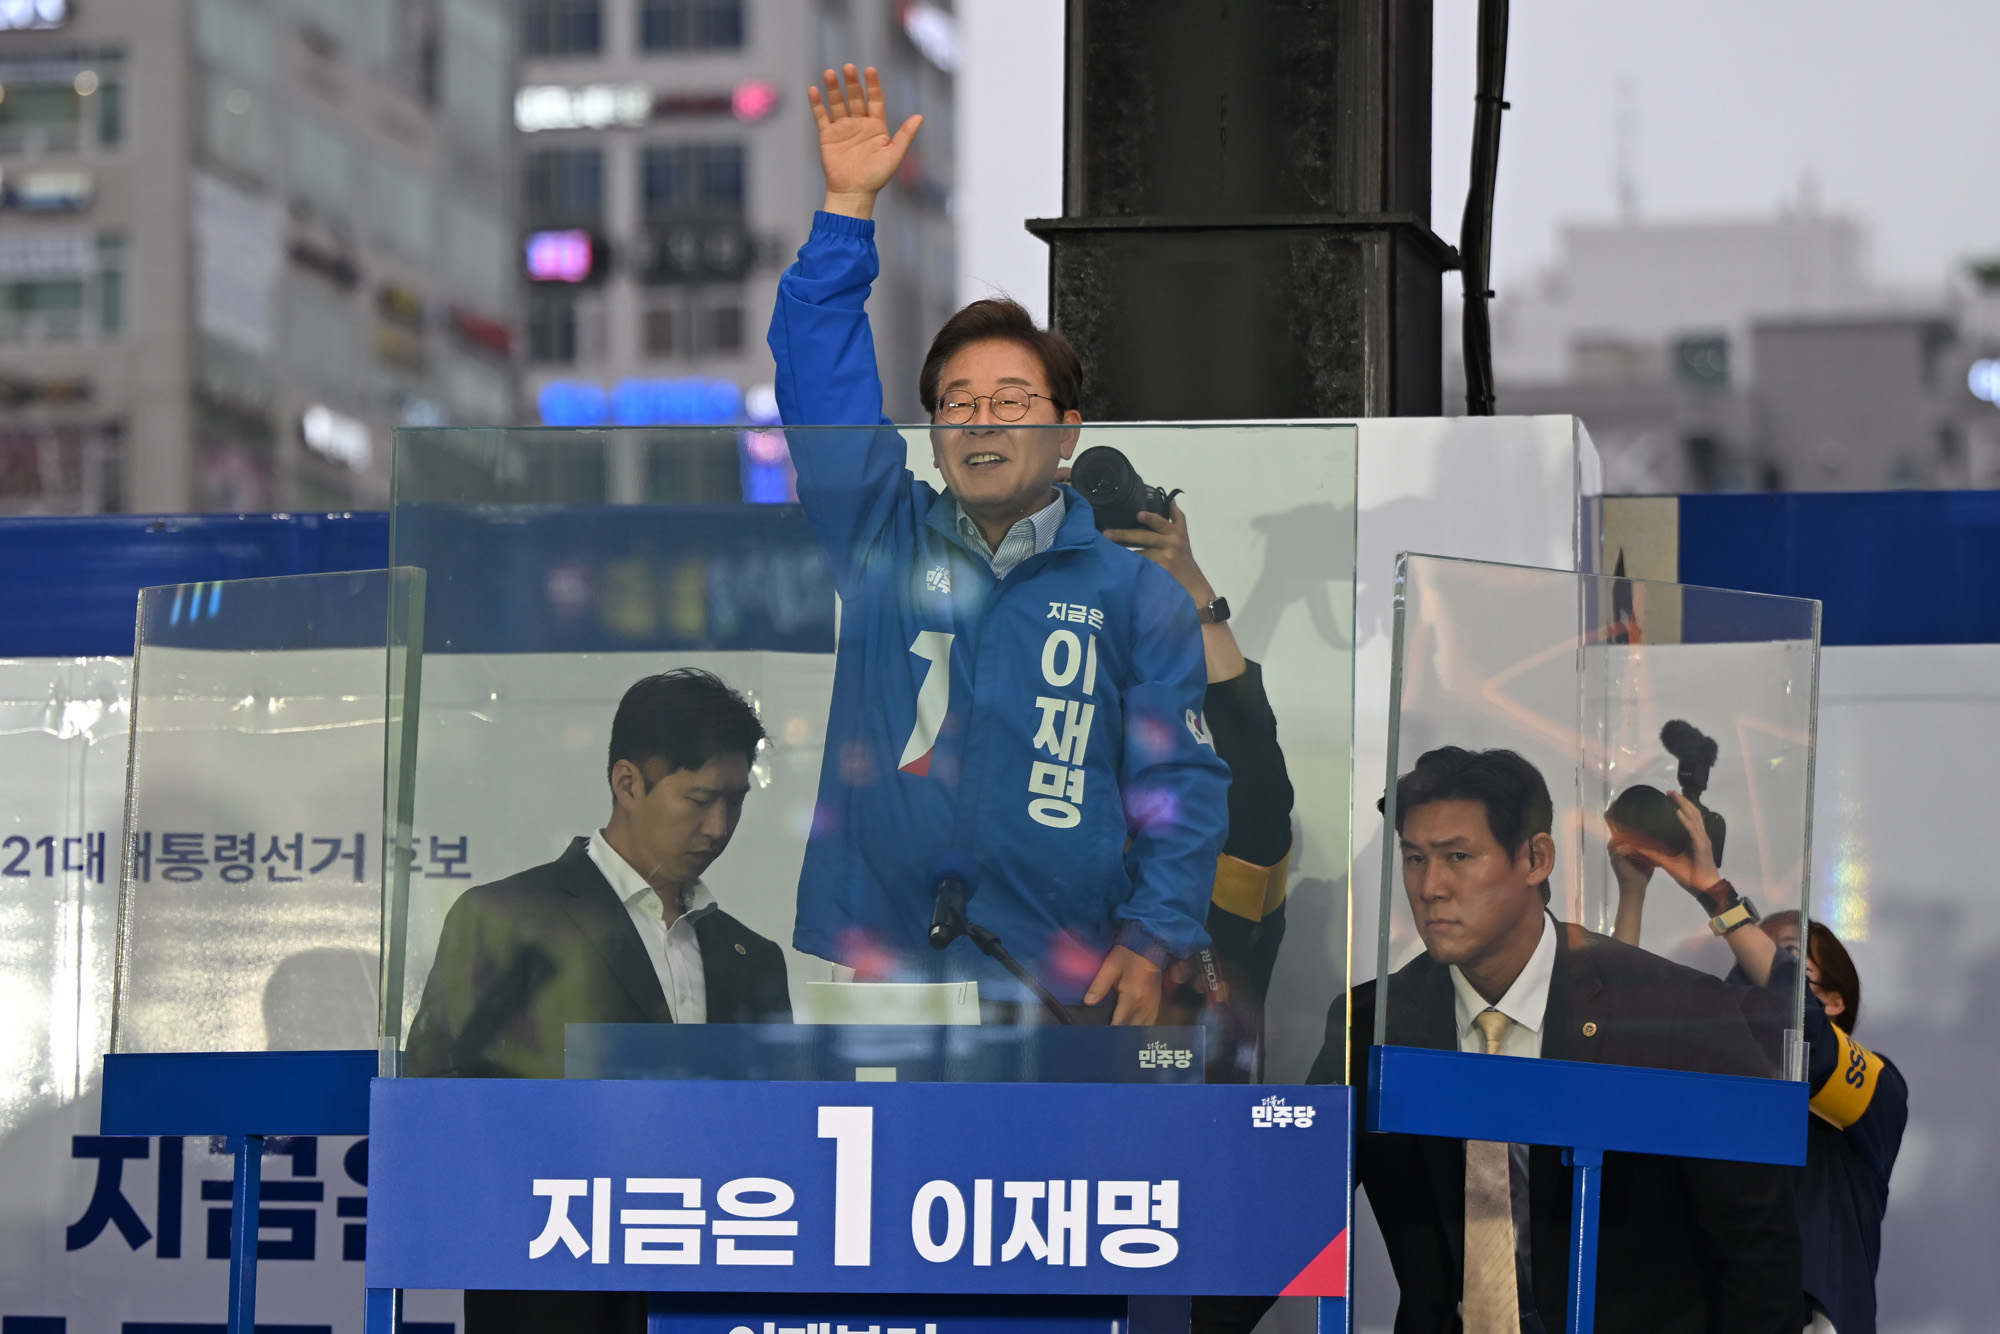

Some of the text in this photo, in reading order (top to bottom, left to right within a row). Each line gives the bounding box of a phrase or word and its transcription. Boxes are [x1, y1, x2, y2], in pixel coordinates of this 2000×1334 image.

[1046, 602, 1104, 630] 지금은
[1027, 629, 1097, 829] 이재명
[1204, 963, 1218, 991] EOS
[1138, 1050, 1193, 1069] 민주당
[1251, 1105, 1316, 1128] 민주당
[66, 1135, 368, 1261] 지금
[529, 1106, 1180, 1268] 지금은 1 이재명
